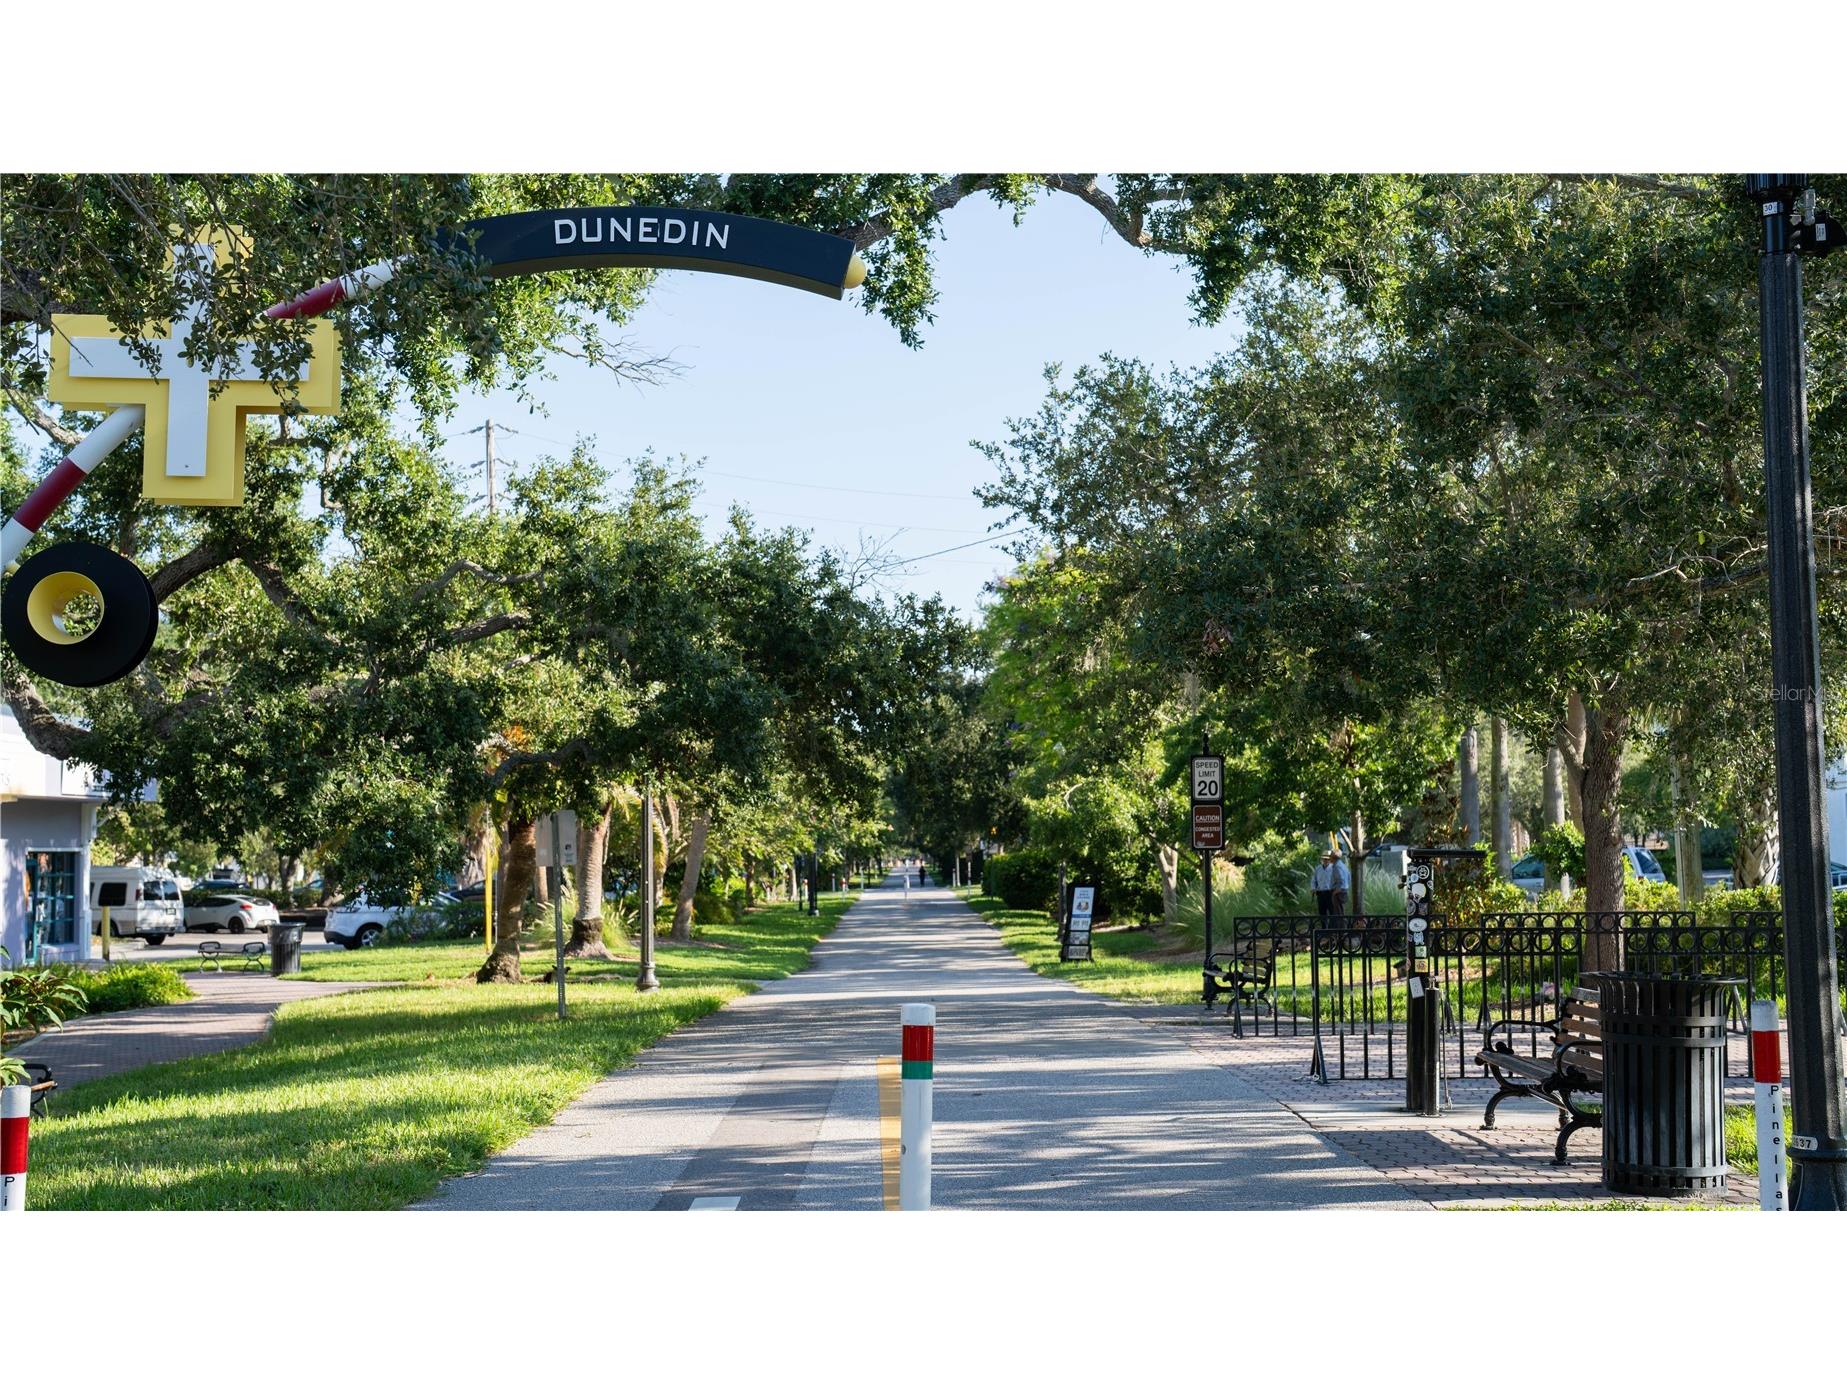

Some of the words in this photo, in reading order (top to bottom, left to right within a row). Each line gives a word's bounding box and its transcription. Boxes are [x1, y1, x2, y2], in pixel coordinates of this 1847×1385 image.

[554, 217, 730, 249] DUNEDIN
[1195, 761, 1219, 769] SPEED
[1198, 770, 1216, 778] LIMIT
[1197, 780, 1218, 797] 20
